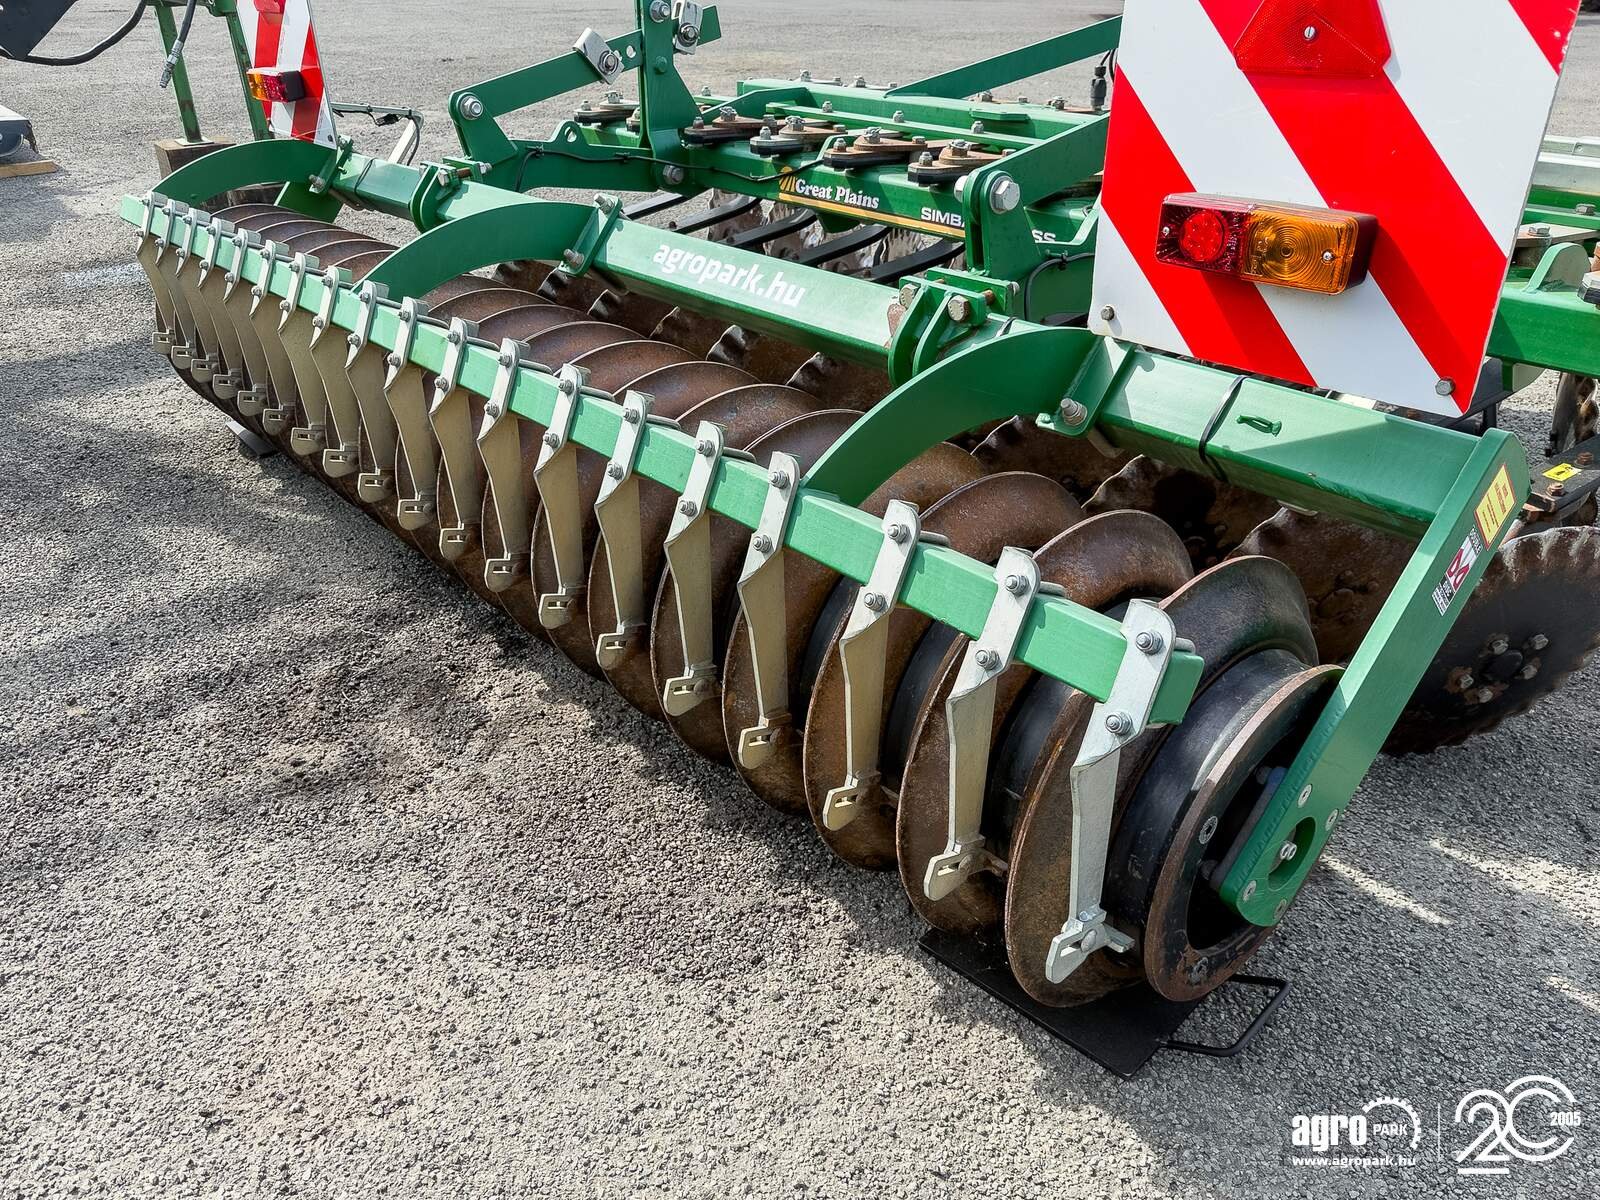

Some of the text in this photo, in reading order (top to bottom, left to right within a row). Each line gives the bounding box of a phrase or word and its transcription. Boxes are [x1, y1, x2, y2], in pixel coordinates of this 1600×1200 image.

[795, 178, 879, 209] Great Plains
[652, 244, 806, 307] agropark.hu
